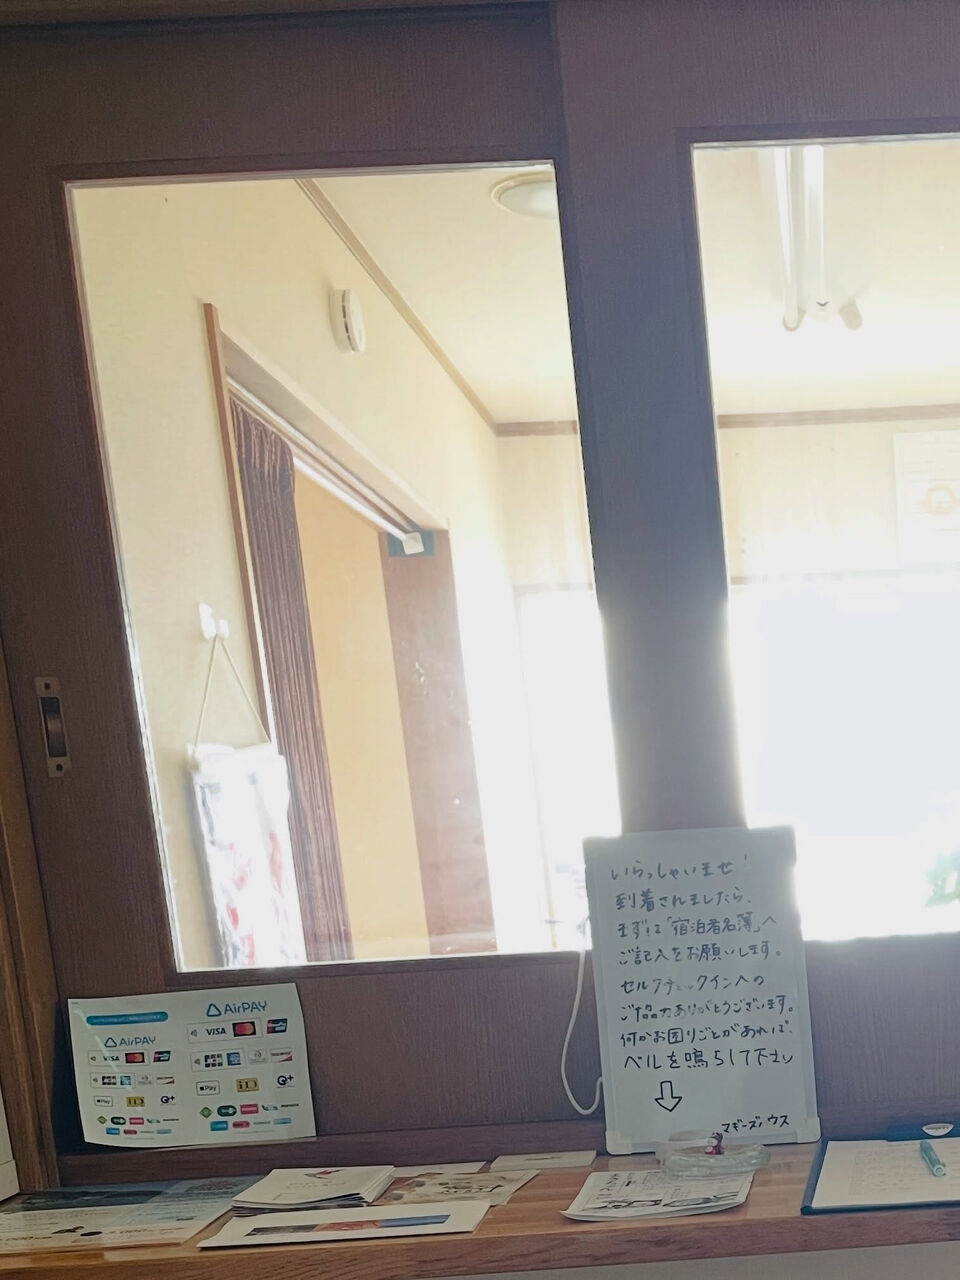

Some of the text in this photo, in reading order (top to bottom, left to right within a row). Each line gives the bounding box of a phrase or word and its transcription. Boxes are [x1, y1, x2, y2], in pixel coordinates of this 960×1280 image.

[618, 941, 782, 966] ご記入をお願いします。
[224, 1001, 268, 1015] AirPAY
[205, 1027, 227, 1036] VISA
[119, 1036, 156, 1047] AirPAY
[624, 1047, 793, 1070] ベルを鳴らして下さい
